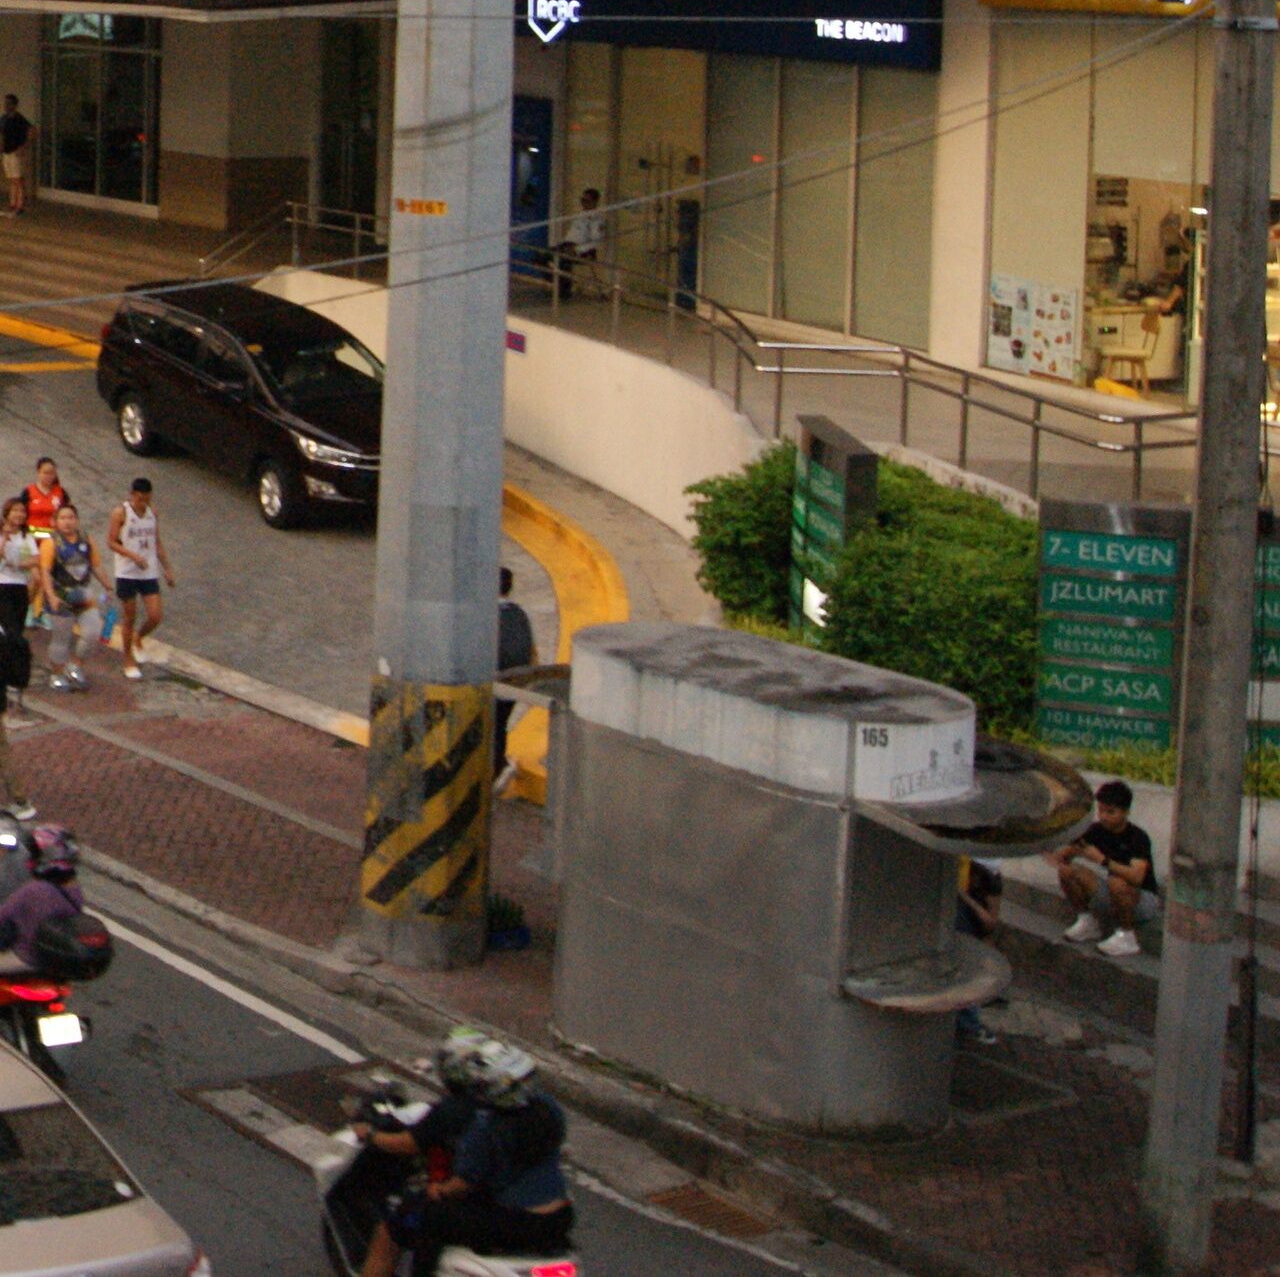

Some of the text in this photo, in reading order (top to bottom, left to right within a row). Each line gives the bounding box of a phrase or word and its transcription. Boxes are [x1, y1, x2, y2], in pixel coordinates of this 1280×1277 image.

[815, 19, 905, 42] THE BEACON
[1078, 540, 1173, 567] ELEVEN
[1050, 581, 1168, 605] JZLUMART
[1102, 677, 1163, 702] SASA
[862, 727, 889, 747] 165
